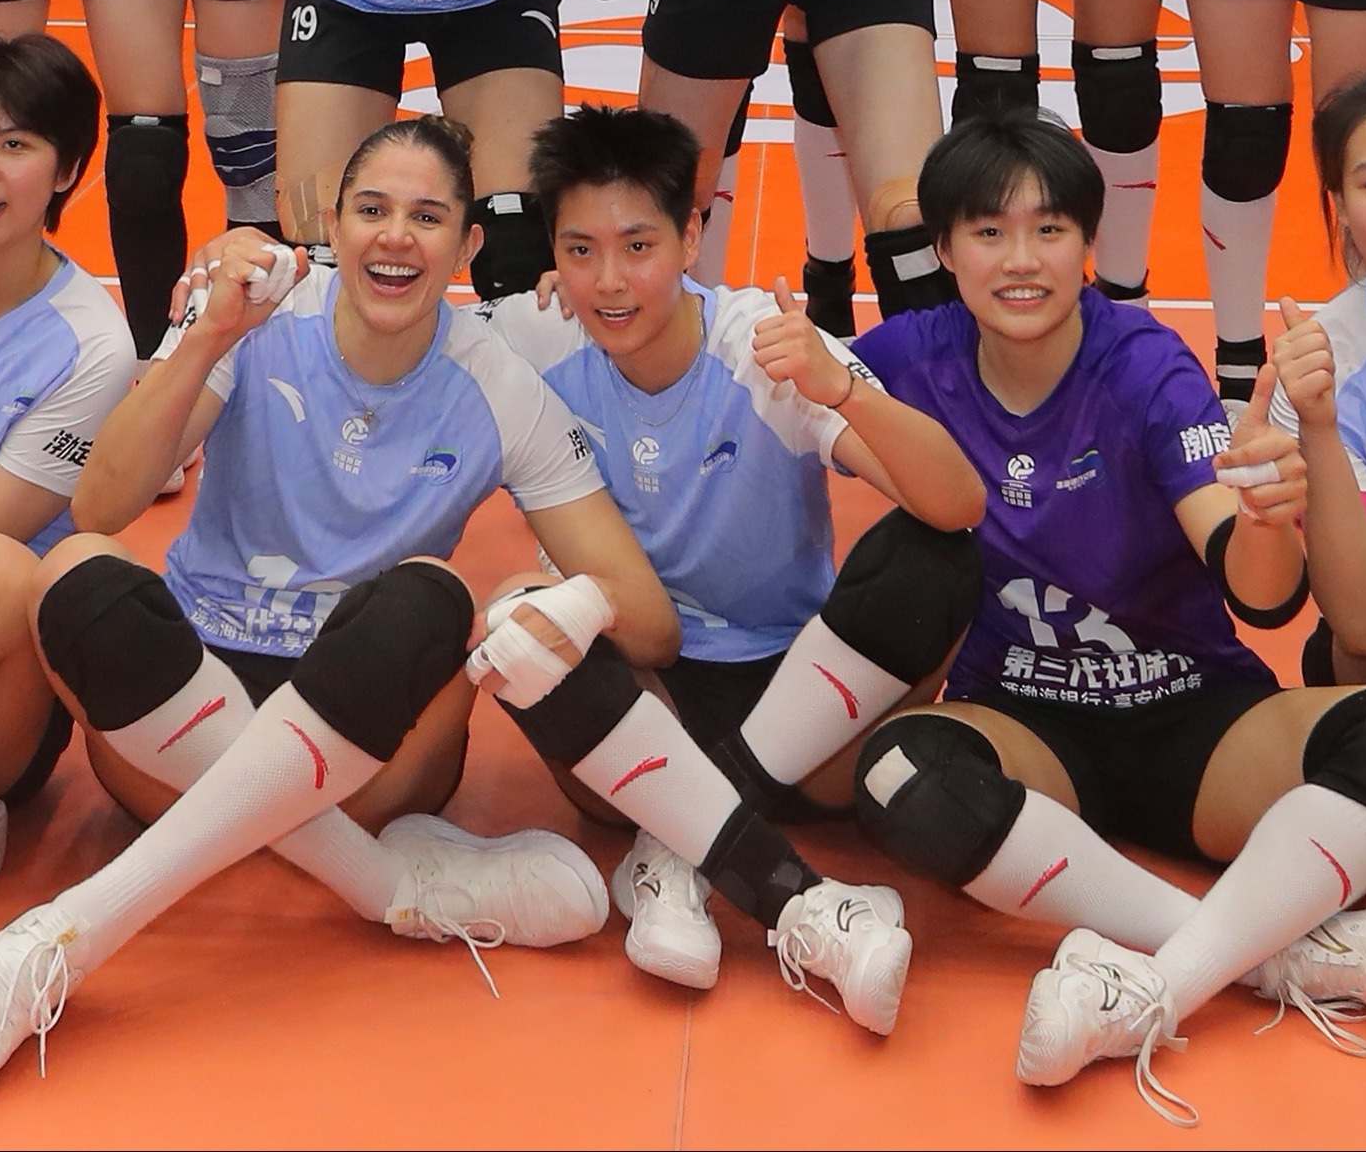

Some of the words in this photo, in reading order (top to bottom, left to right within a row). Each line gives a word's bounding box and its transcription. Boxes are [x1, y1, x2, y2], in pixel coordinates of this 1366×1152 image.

[291, 5, 317, 41] 19
[42, 429, 95, 467] 渤定
[1179, 423, 1232, 464] 渤定
